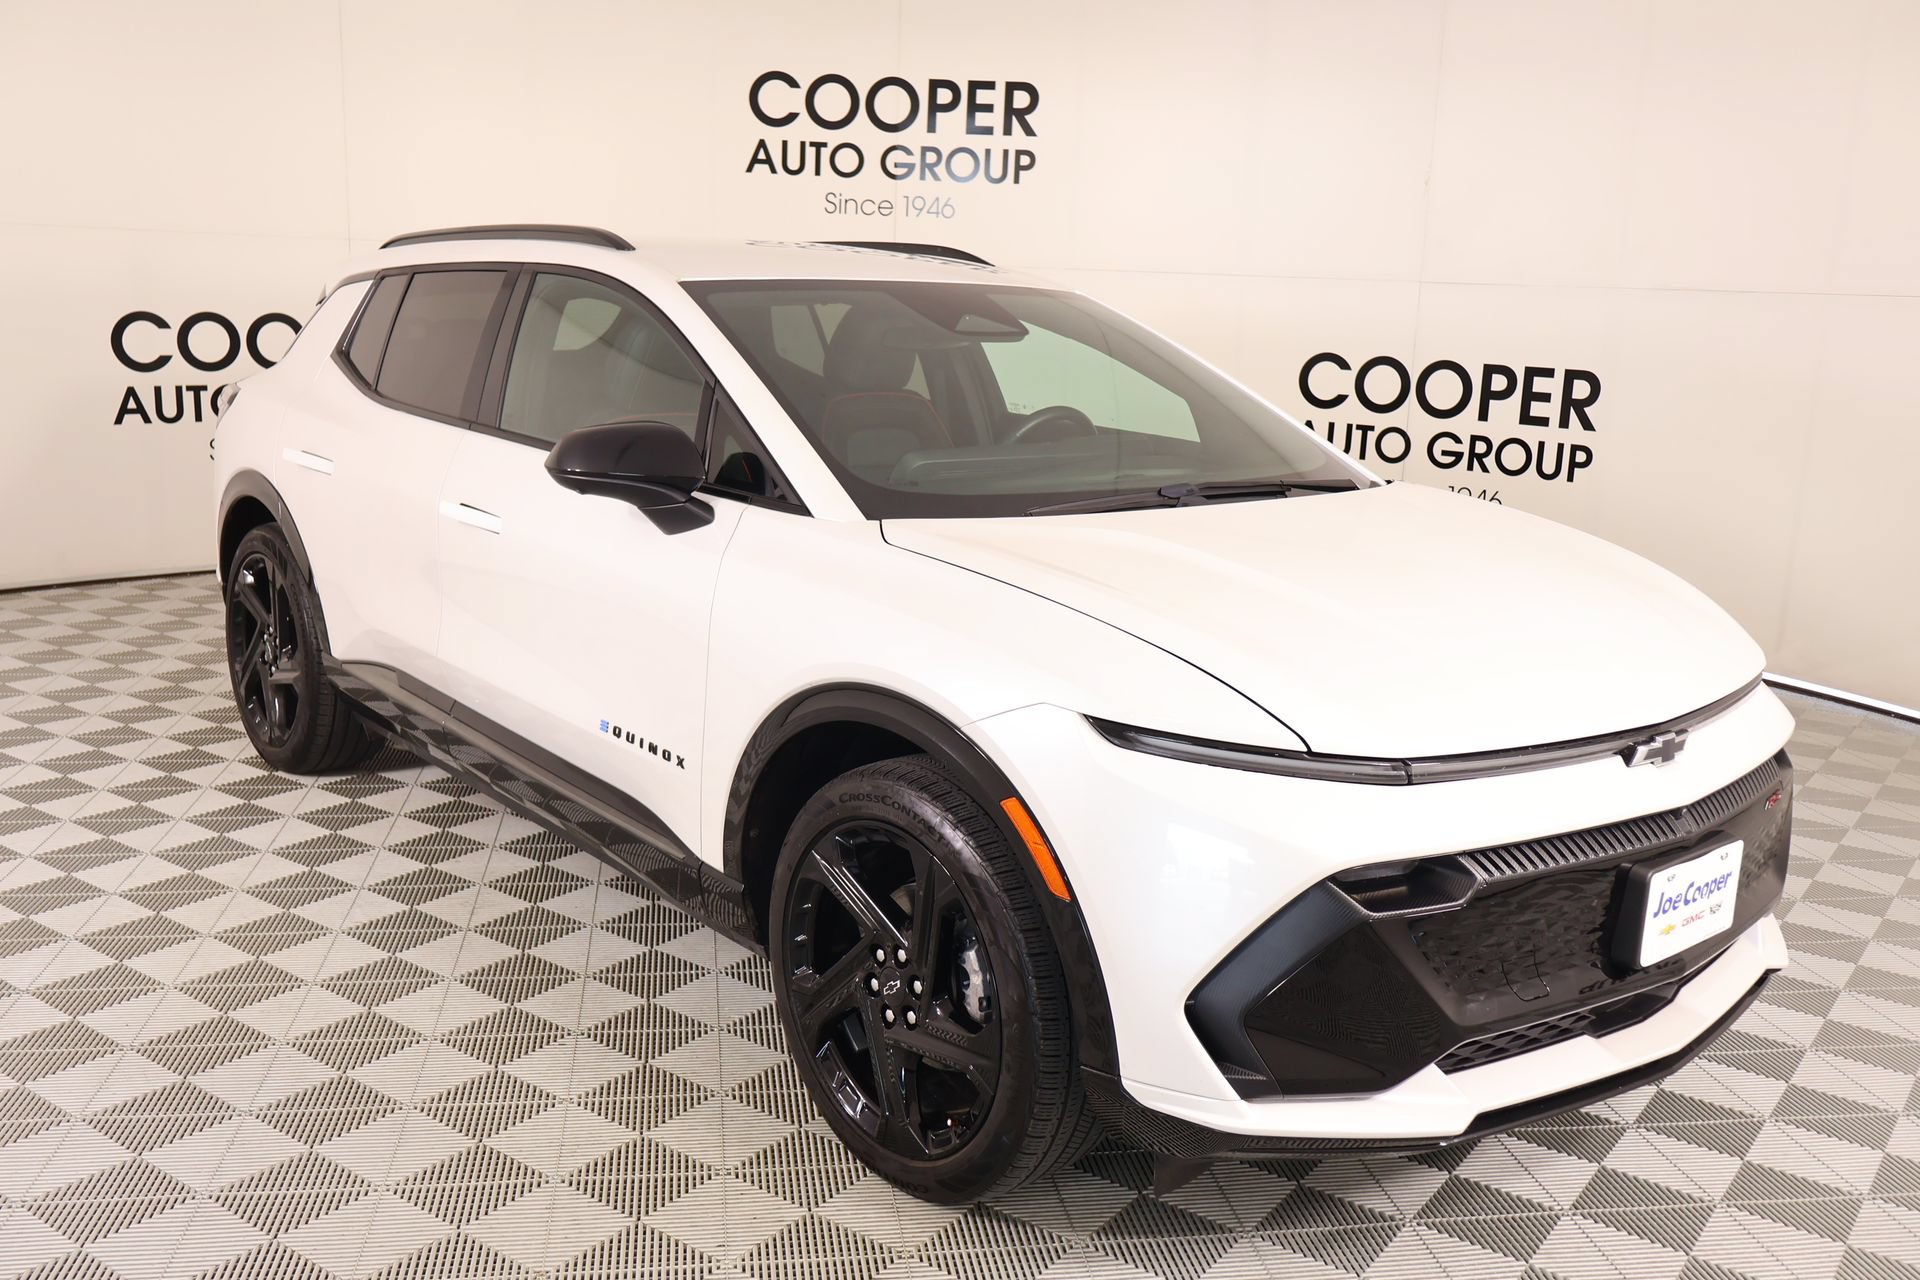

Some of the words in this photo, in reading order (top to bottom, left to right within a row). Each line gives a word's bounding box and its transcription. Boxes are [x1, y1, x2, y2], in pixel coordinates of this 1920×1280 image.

[748, 70, 1040, 137] COOPER
[745, 138, 865, 179] AUTO
[880, 144, 1037, 185] GROUP
[824, 191, 894, 217] Since
[902, 195, 956, 219] 1946
[1298, 351, 1602, 432] COOPER
[1304, 419, 1412, 464] UTO
[1426, 431, 1594, 483] GROUP
[599, 719, 685, 770] EQUINOX
